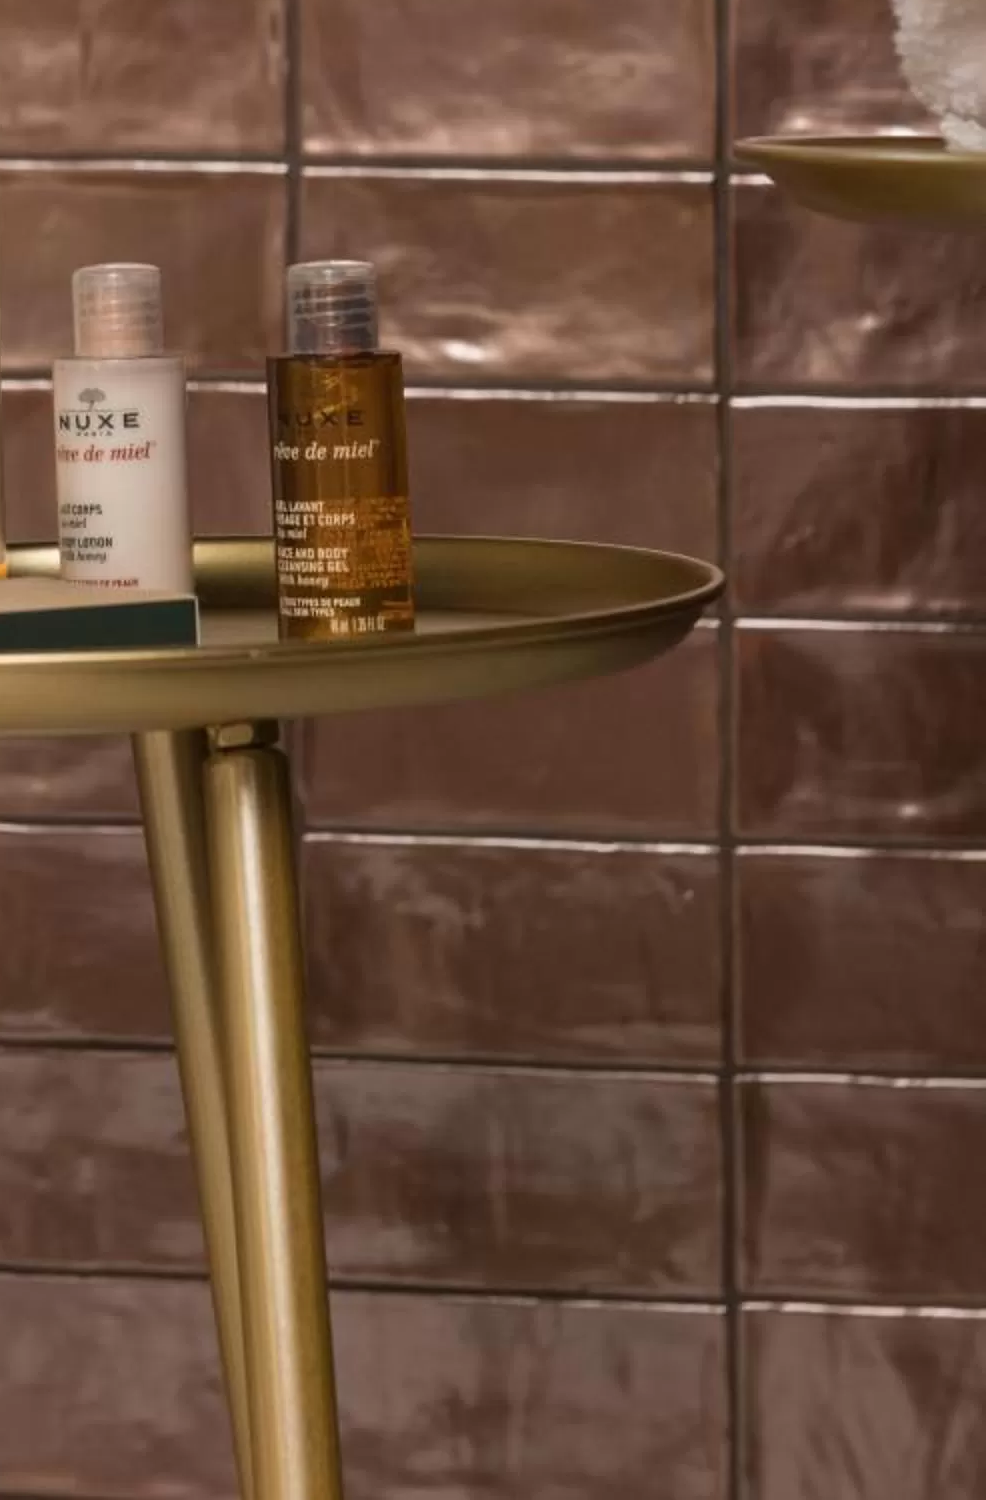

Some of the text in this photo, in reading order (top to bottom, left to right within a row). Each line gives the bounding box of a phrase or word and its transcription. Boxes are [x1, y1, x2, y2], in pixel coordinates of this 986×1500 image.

[59, 411, 140, 430] NUXE
[83, 445, 104, 462] de
[306, 441, 327, 460] de
[71, 504, 103, 516] CORPS
[318, 513, 356, 526] CORPS
[317, 547, 350, 559] BODY
[327, 560, 350, 573] GEL
